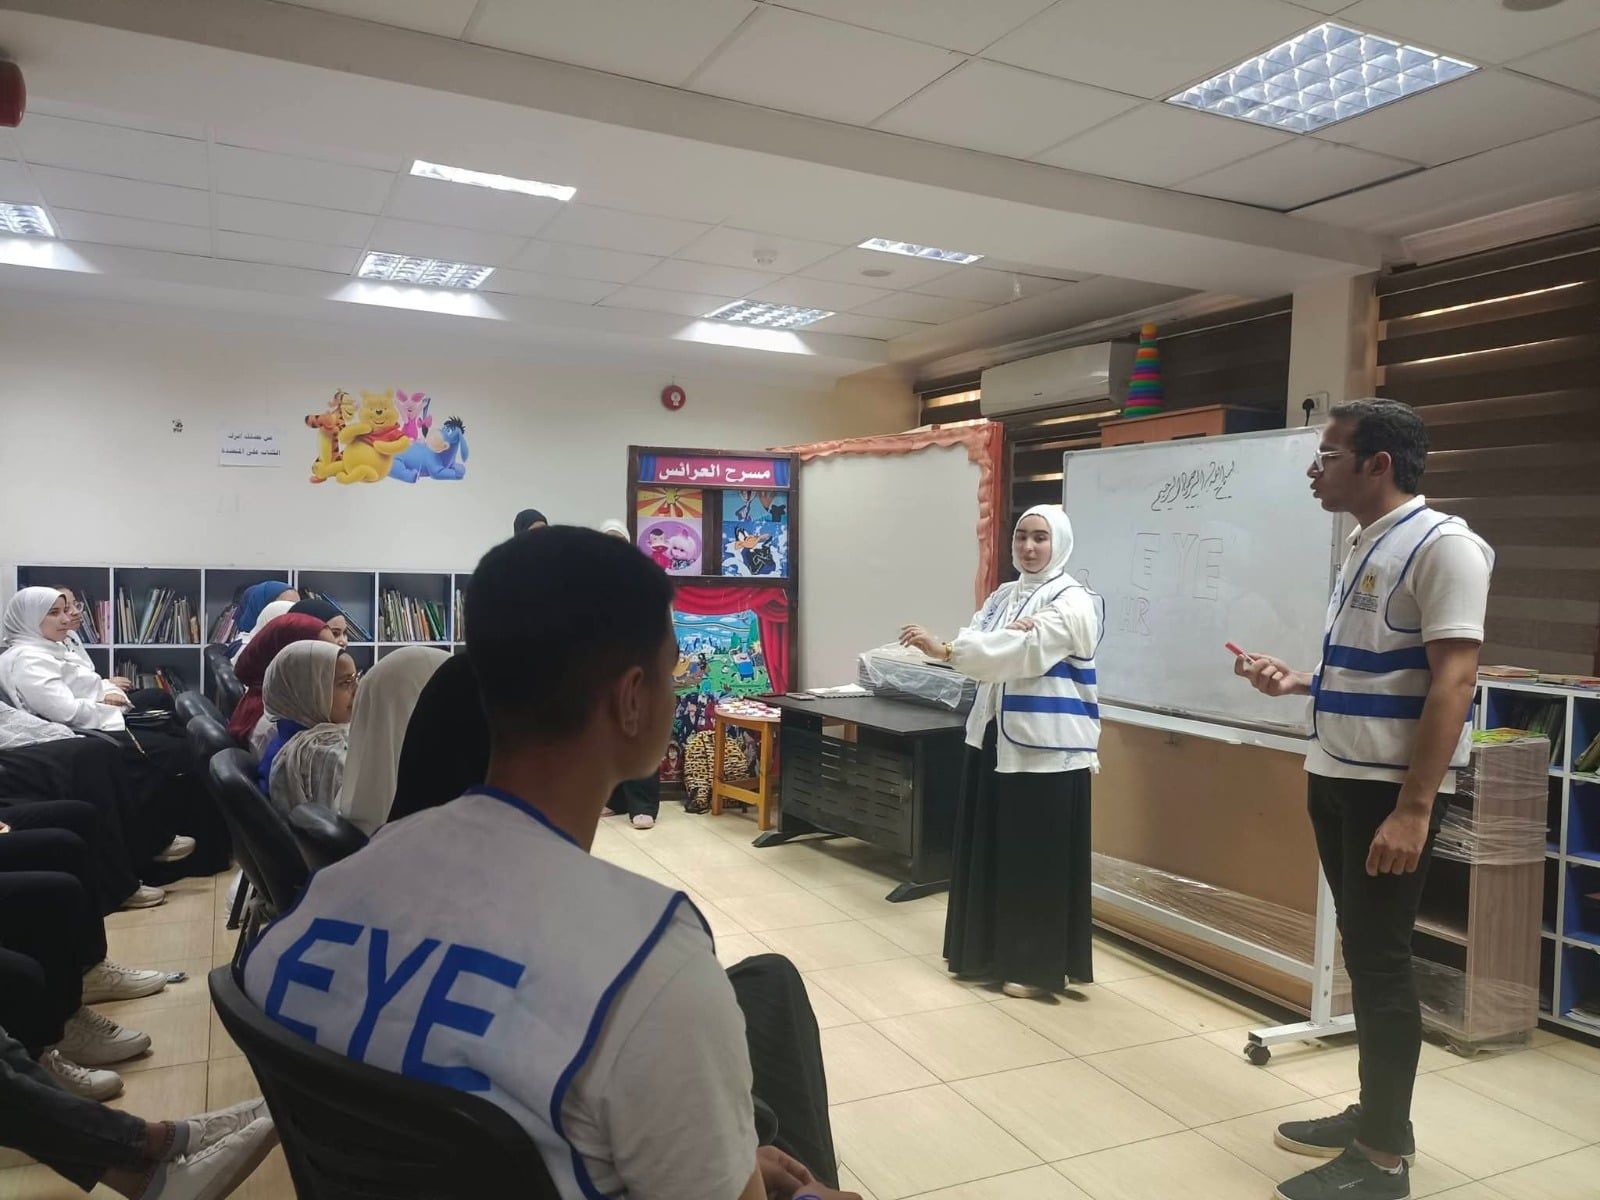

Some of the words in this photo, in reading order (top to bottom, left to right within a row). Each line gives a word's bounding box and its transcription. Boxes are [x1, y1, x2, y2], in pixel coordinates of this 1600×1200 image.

[659, 462, 720, 481] العرائس
[725, 466, 771, 482] مسرح
[1129, 532, 1224, 602] EYE
[265, 917, 526, 1092] EYE
